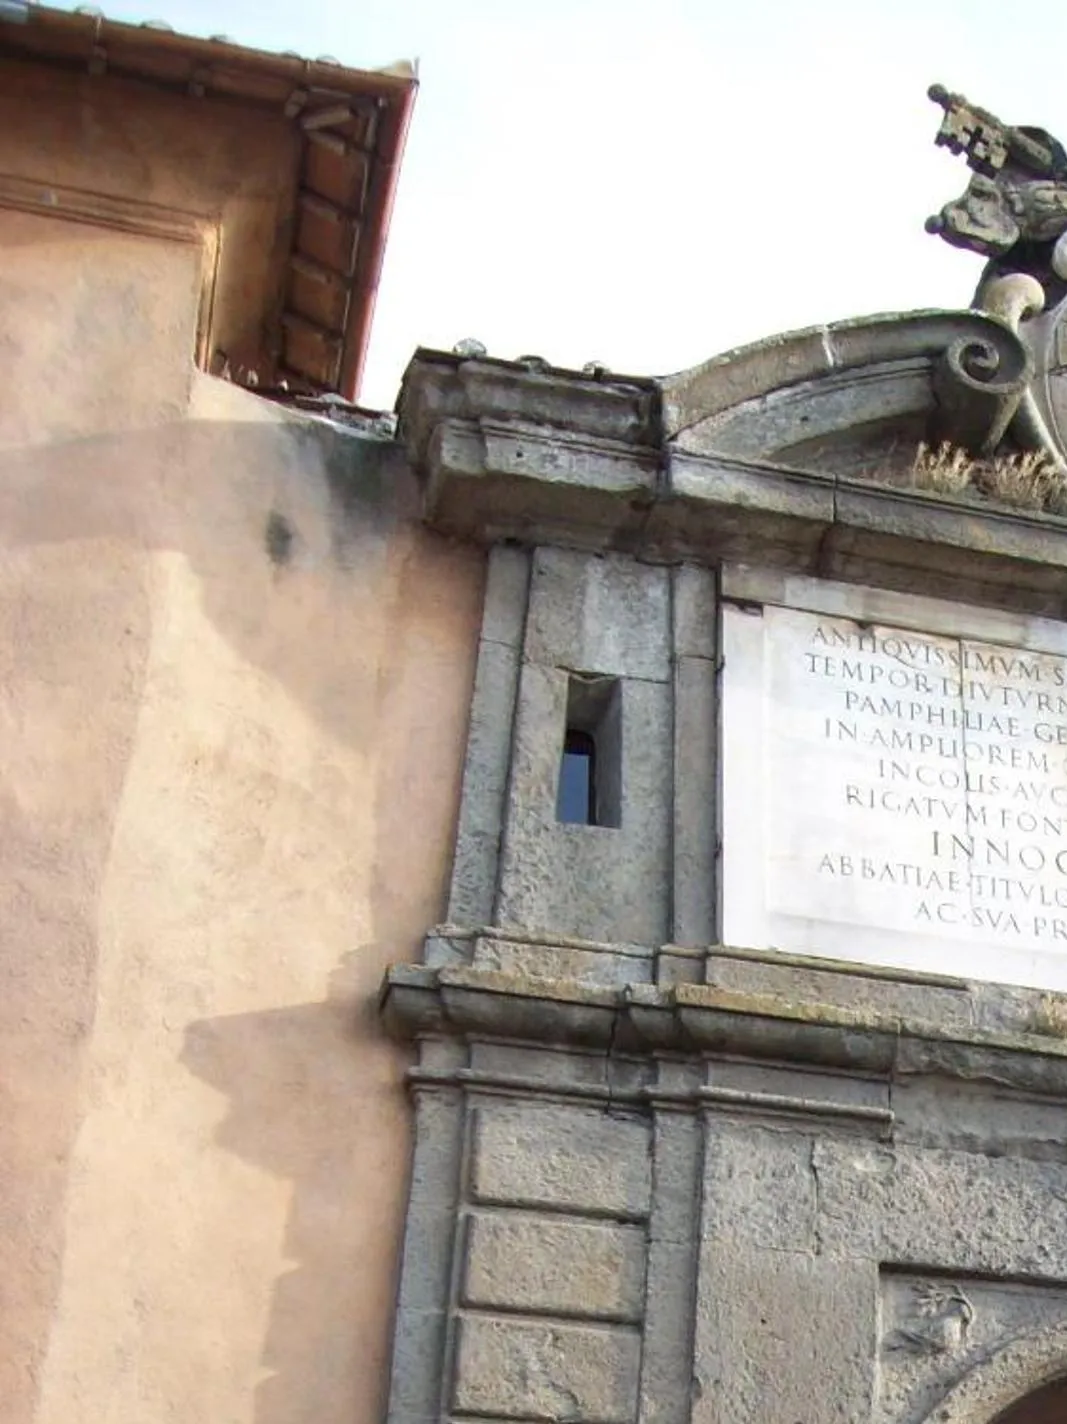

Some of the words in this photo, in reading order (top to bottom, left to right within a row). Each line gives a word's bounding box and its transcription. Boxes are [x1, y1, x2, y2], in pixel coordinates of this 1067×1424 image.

[812, 626, 1041, 682] ANTIQVISSIMVM
[844, 690, 1021, 737] PAMPHILIAE
[824, 717, 858, 741] IN
[870, 728, 1049, 774] AMPLIOREM
[879, 759, 1001, 794] INCOLIS
[846, 784, 987, 826] RIGATVM
[818, 853, 960, 892] ABBATIAE
[914, 901, 958, 923] AC
[970, 906, 1021, 935] SVA
